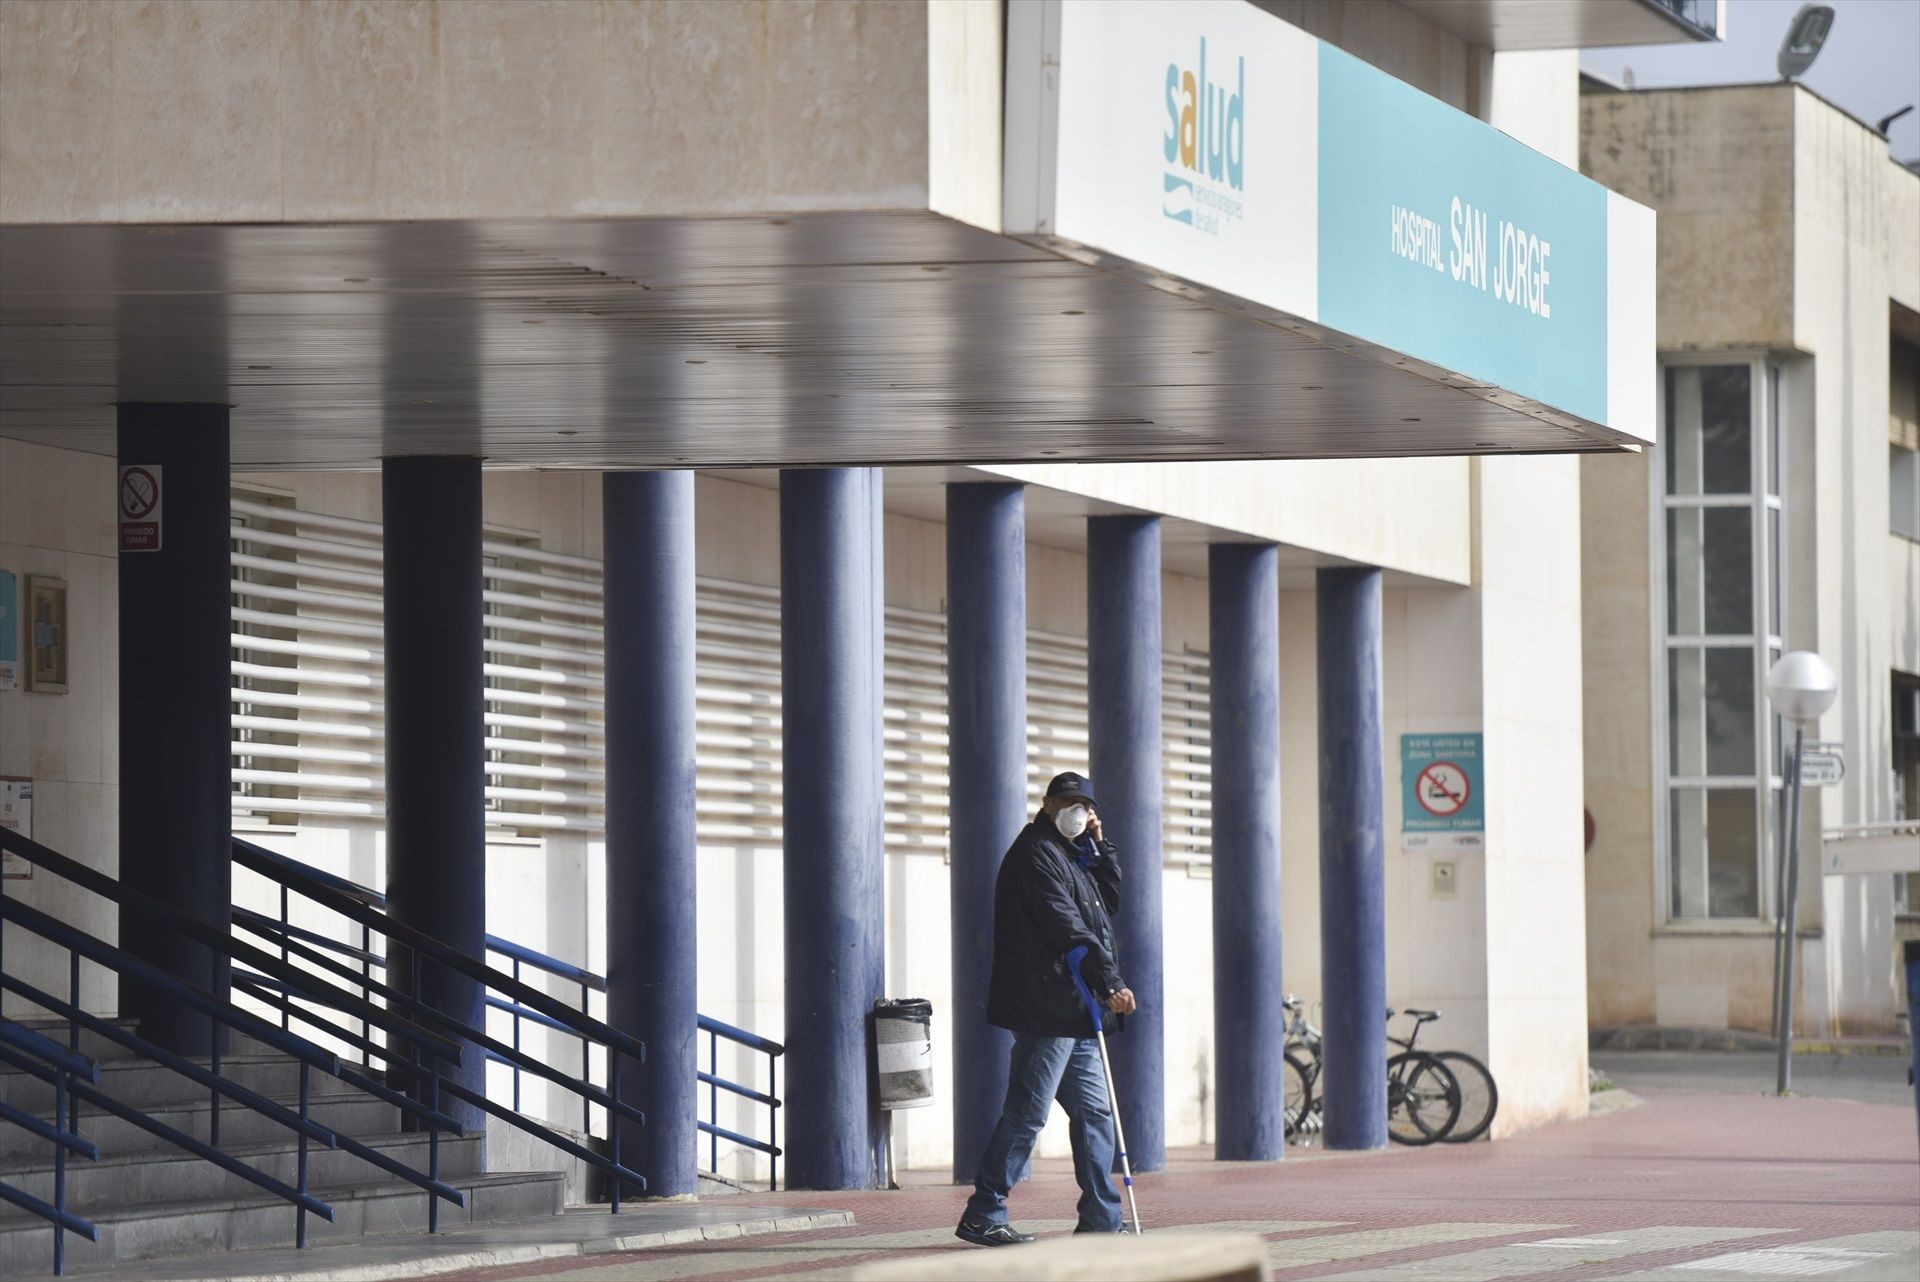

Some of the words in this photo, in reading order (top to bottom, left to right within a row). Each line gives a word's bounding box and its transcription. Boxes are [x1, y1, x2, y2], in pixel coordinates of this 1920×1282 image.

[1164, 35, 1245, 191] salud
[1391, 204, 1444, 272] HOSPITAL
[1450, 196, 1487, 291] SAN
[1493, 220, 1550, 319] JORGE
